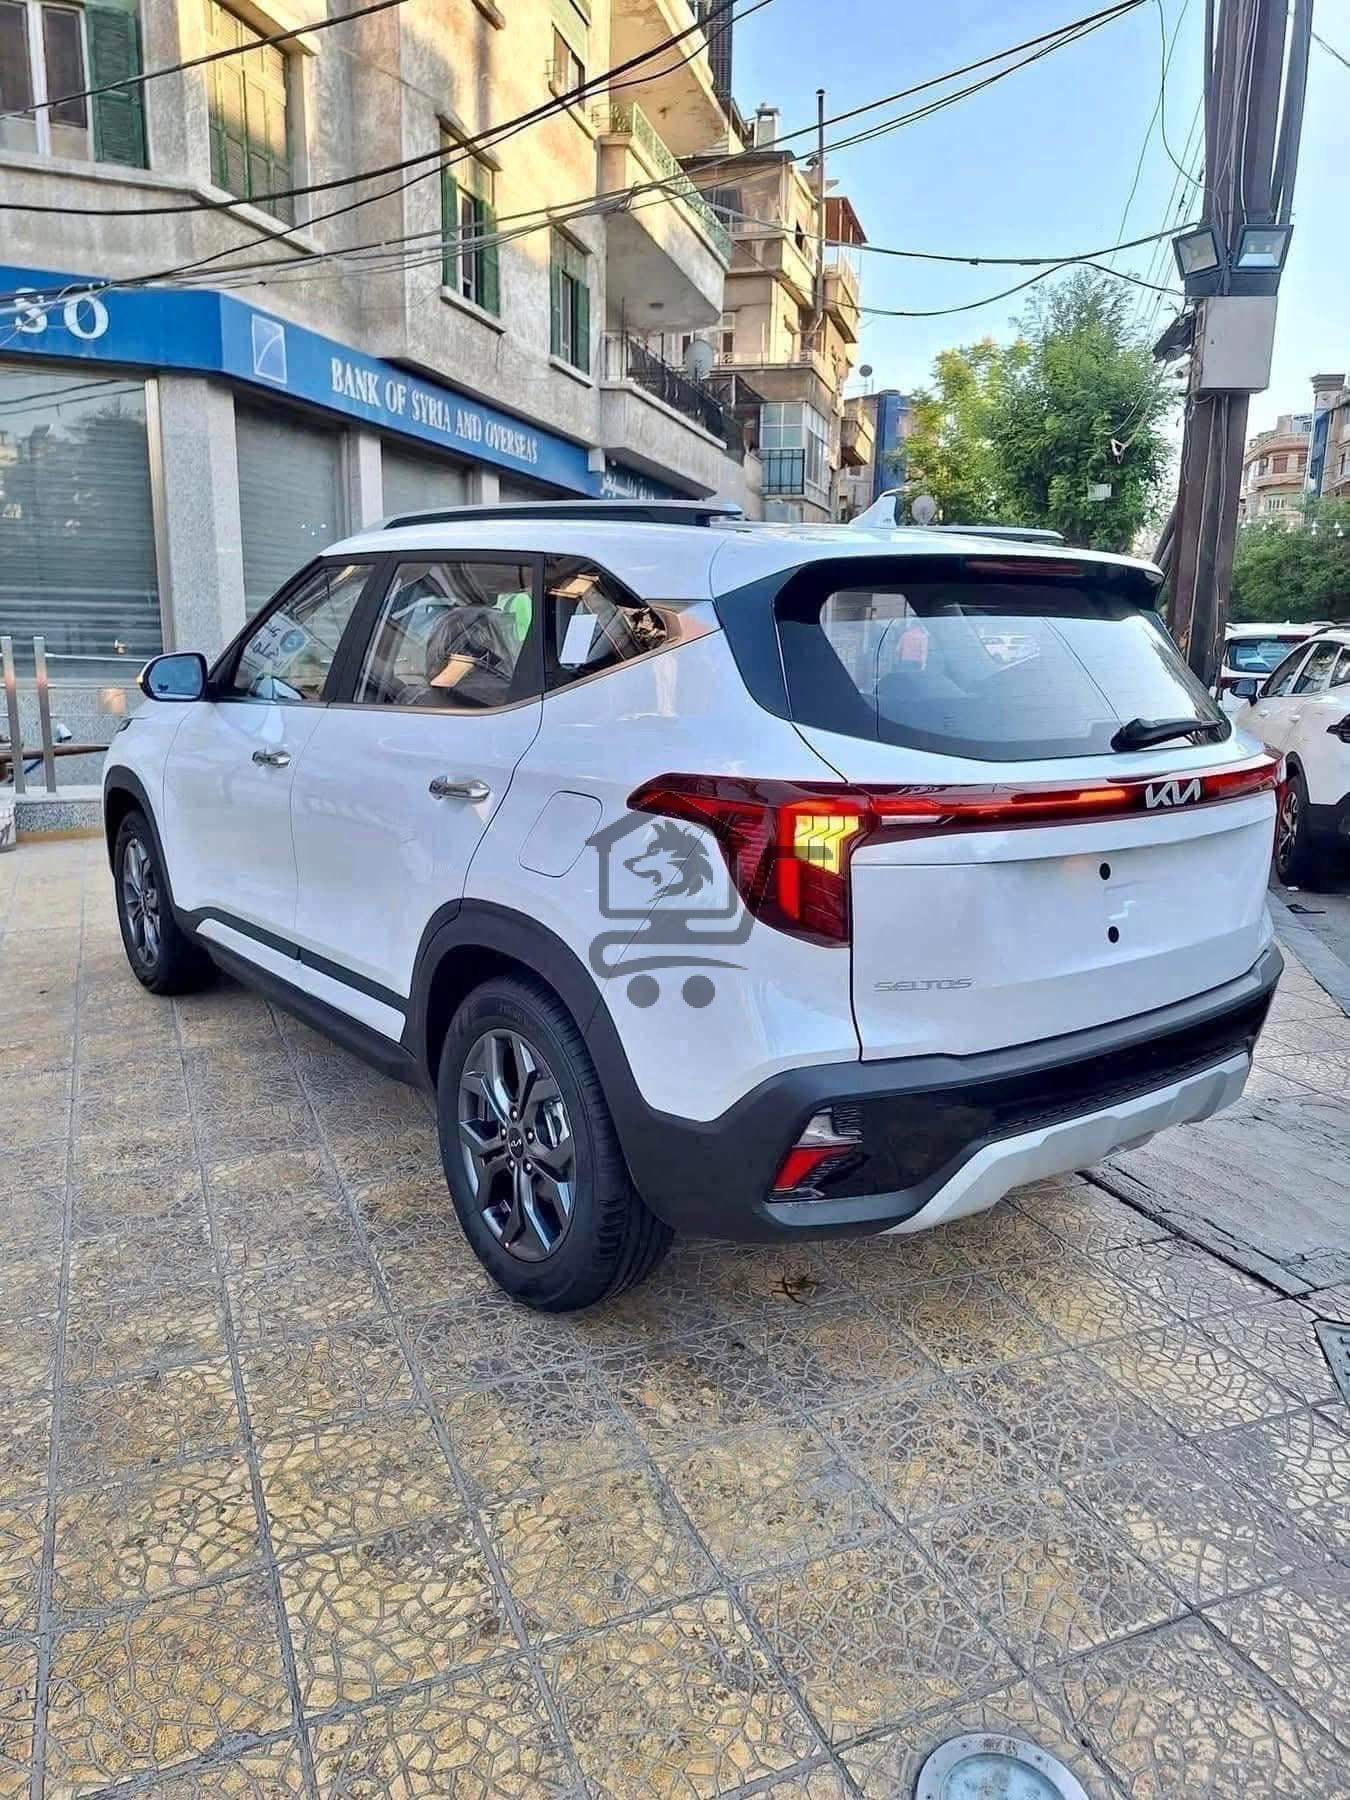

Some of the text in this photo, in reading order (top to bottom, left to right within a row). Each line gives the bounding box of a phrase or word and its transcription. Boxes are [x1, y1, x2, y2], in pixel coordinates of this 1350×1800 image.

[331, 356, 537, 465] BANK OF SYRIA AND OVERSEAS
[1145, 778, 1201, 809] KIA
[873, 978, 973, 993] SELTOS
